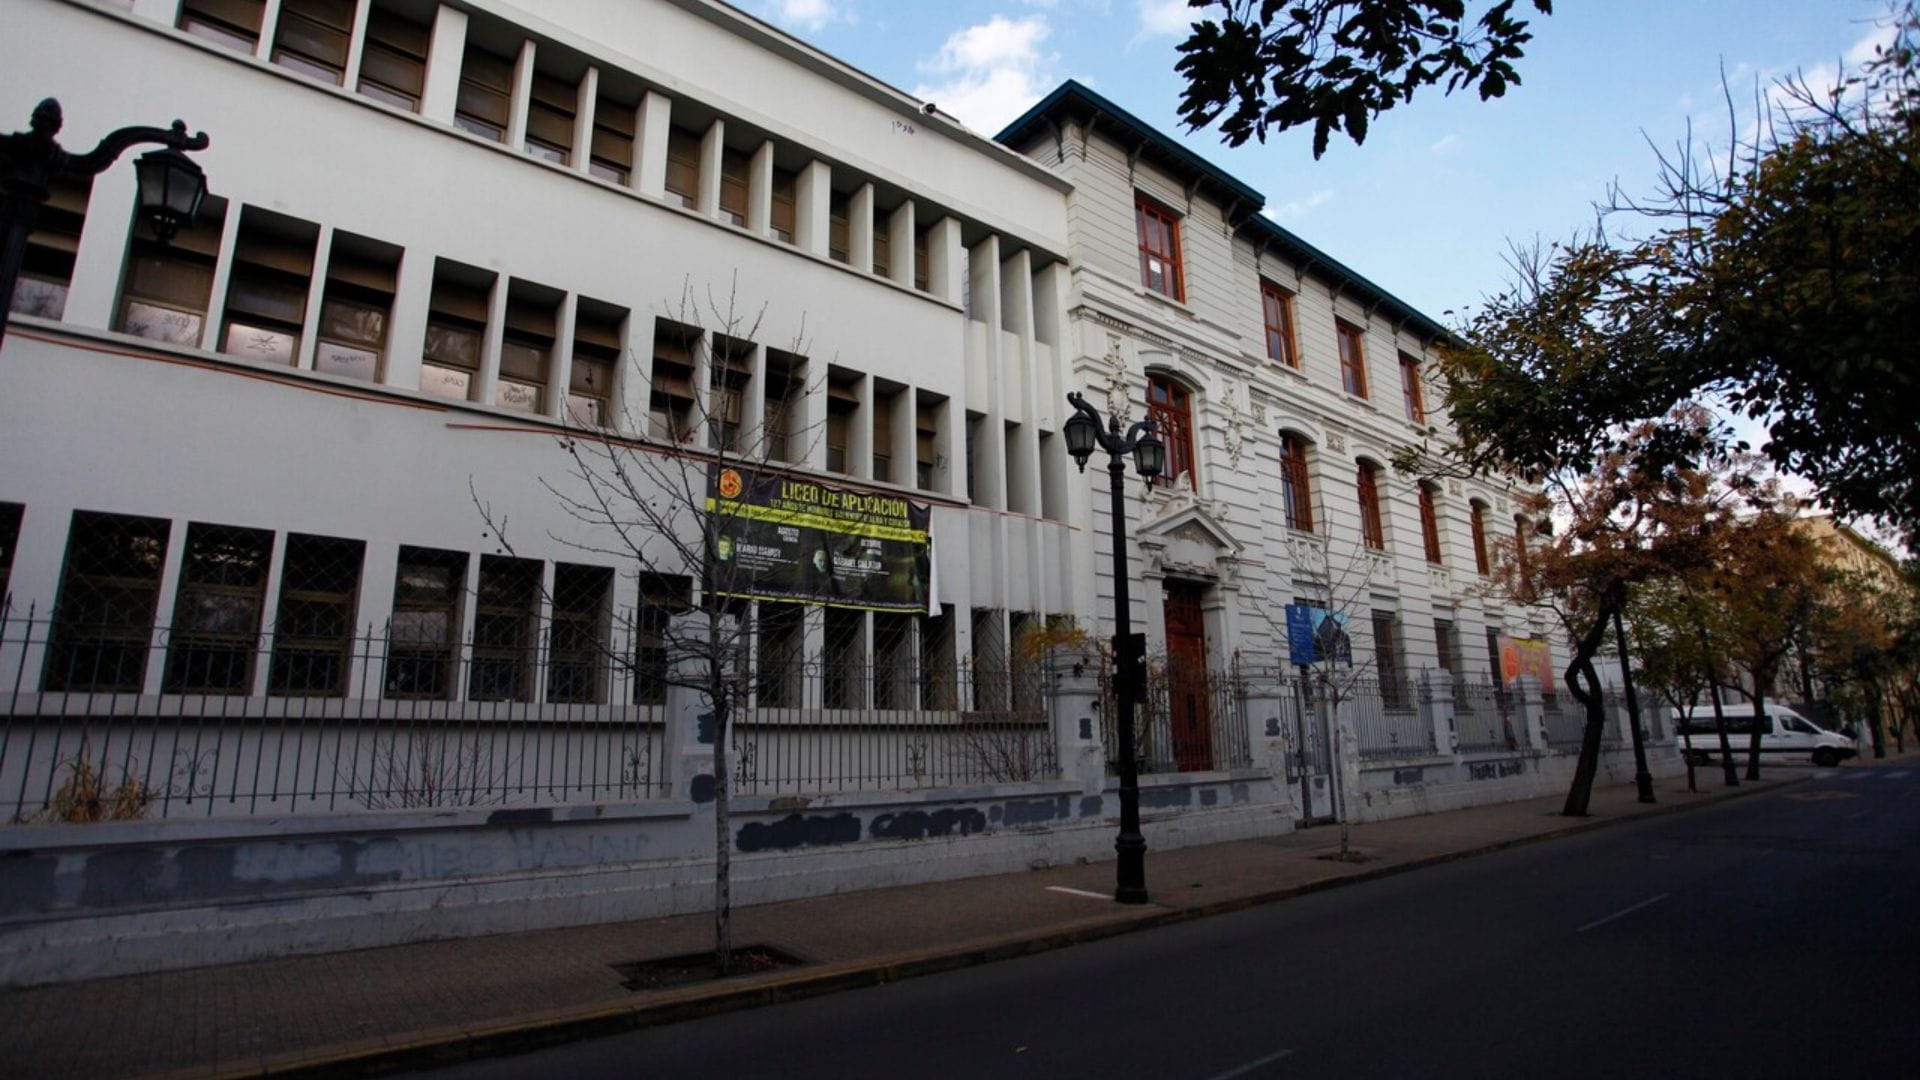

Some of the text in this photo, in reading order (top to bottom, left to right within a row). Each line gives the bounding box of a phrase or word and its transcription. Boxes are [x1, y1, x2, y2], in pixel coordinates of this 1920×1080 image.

[782, 480, 818, 503] LICEO
[821, 489, 839, 507] DE
[842, 494, 908, 518] APLICACIÓN
